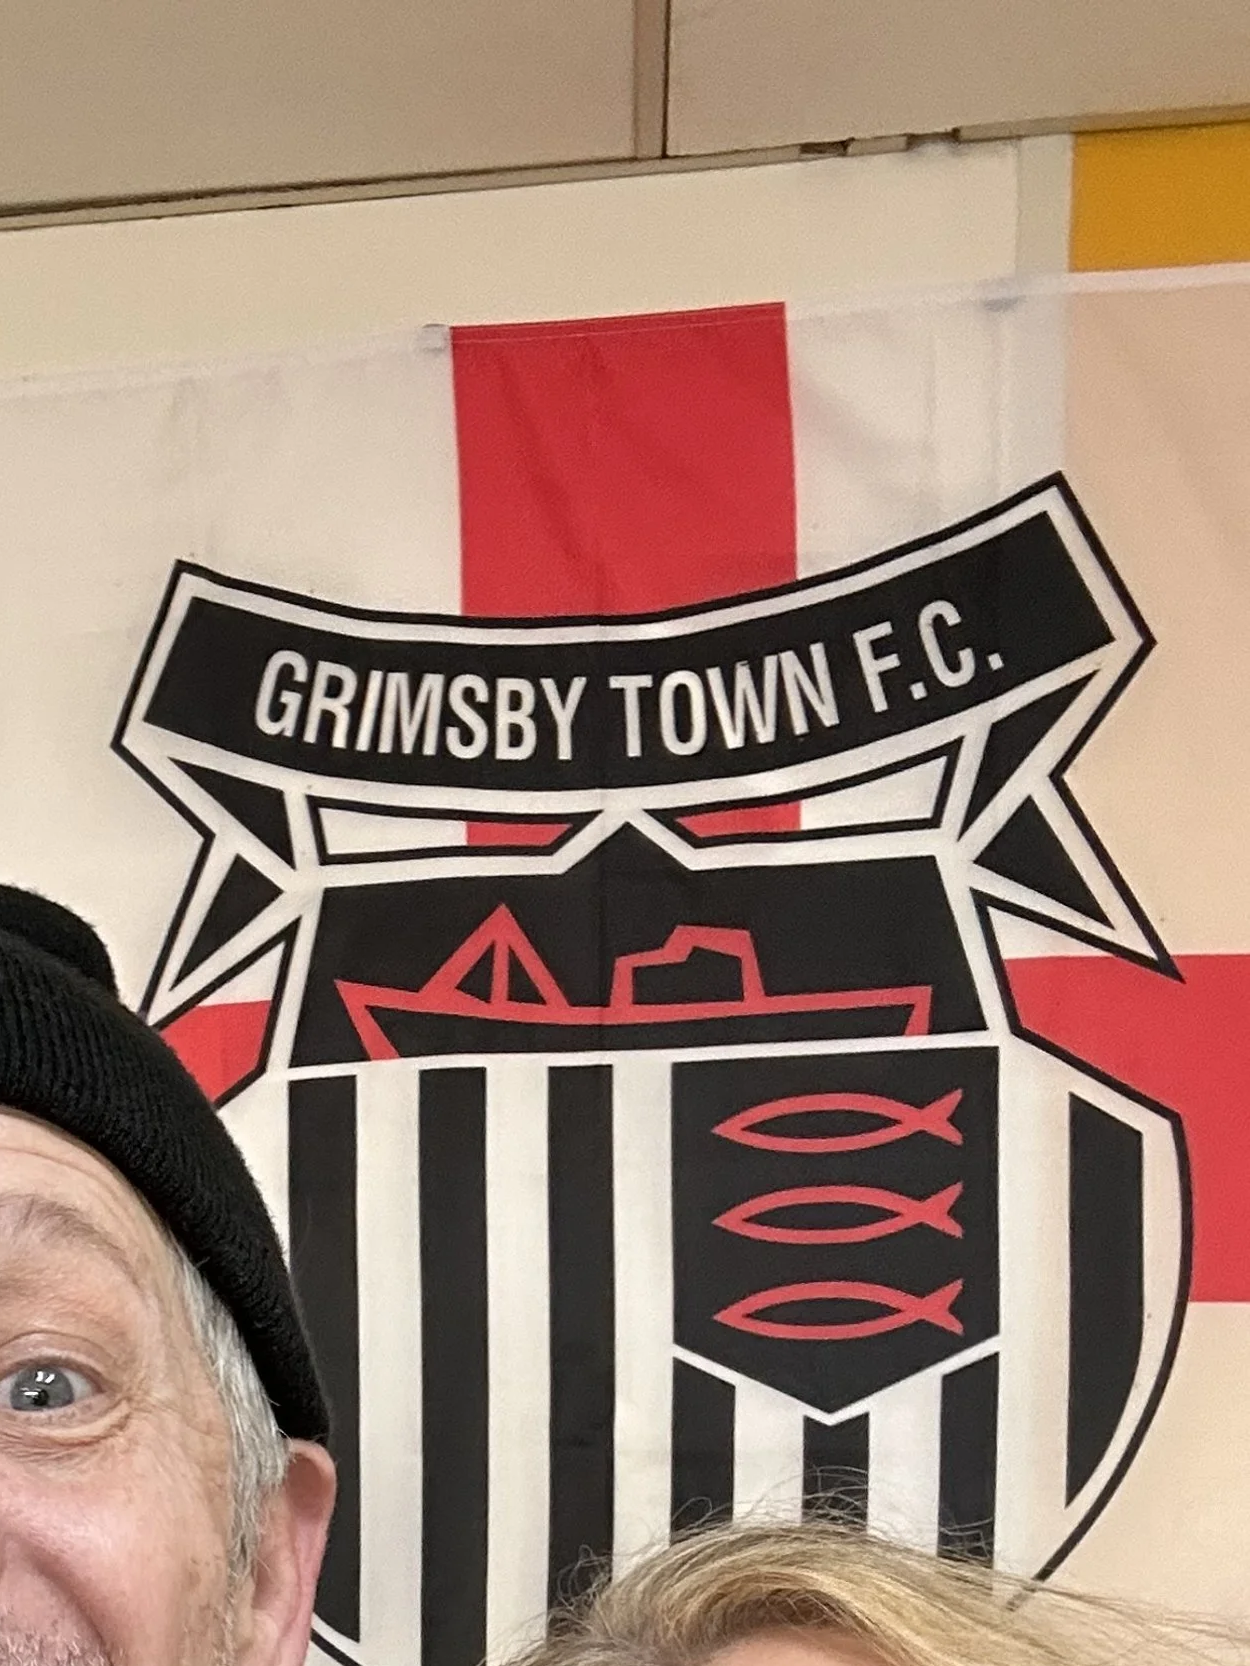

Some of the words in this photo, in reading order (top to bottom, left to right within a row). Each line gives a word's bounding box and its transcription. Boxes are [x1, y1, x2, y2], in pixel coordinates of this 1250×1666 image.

[255, 650, 587, 761] GRIMSBY
[609, 642, 840, 757] TOWN
[852, 600, 1005, 712] F.C.
